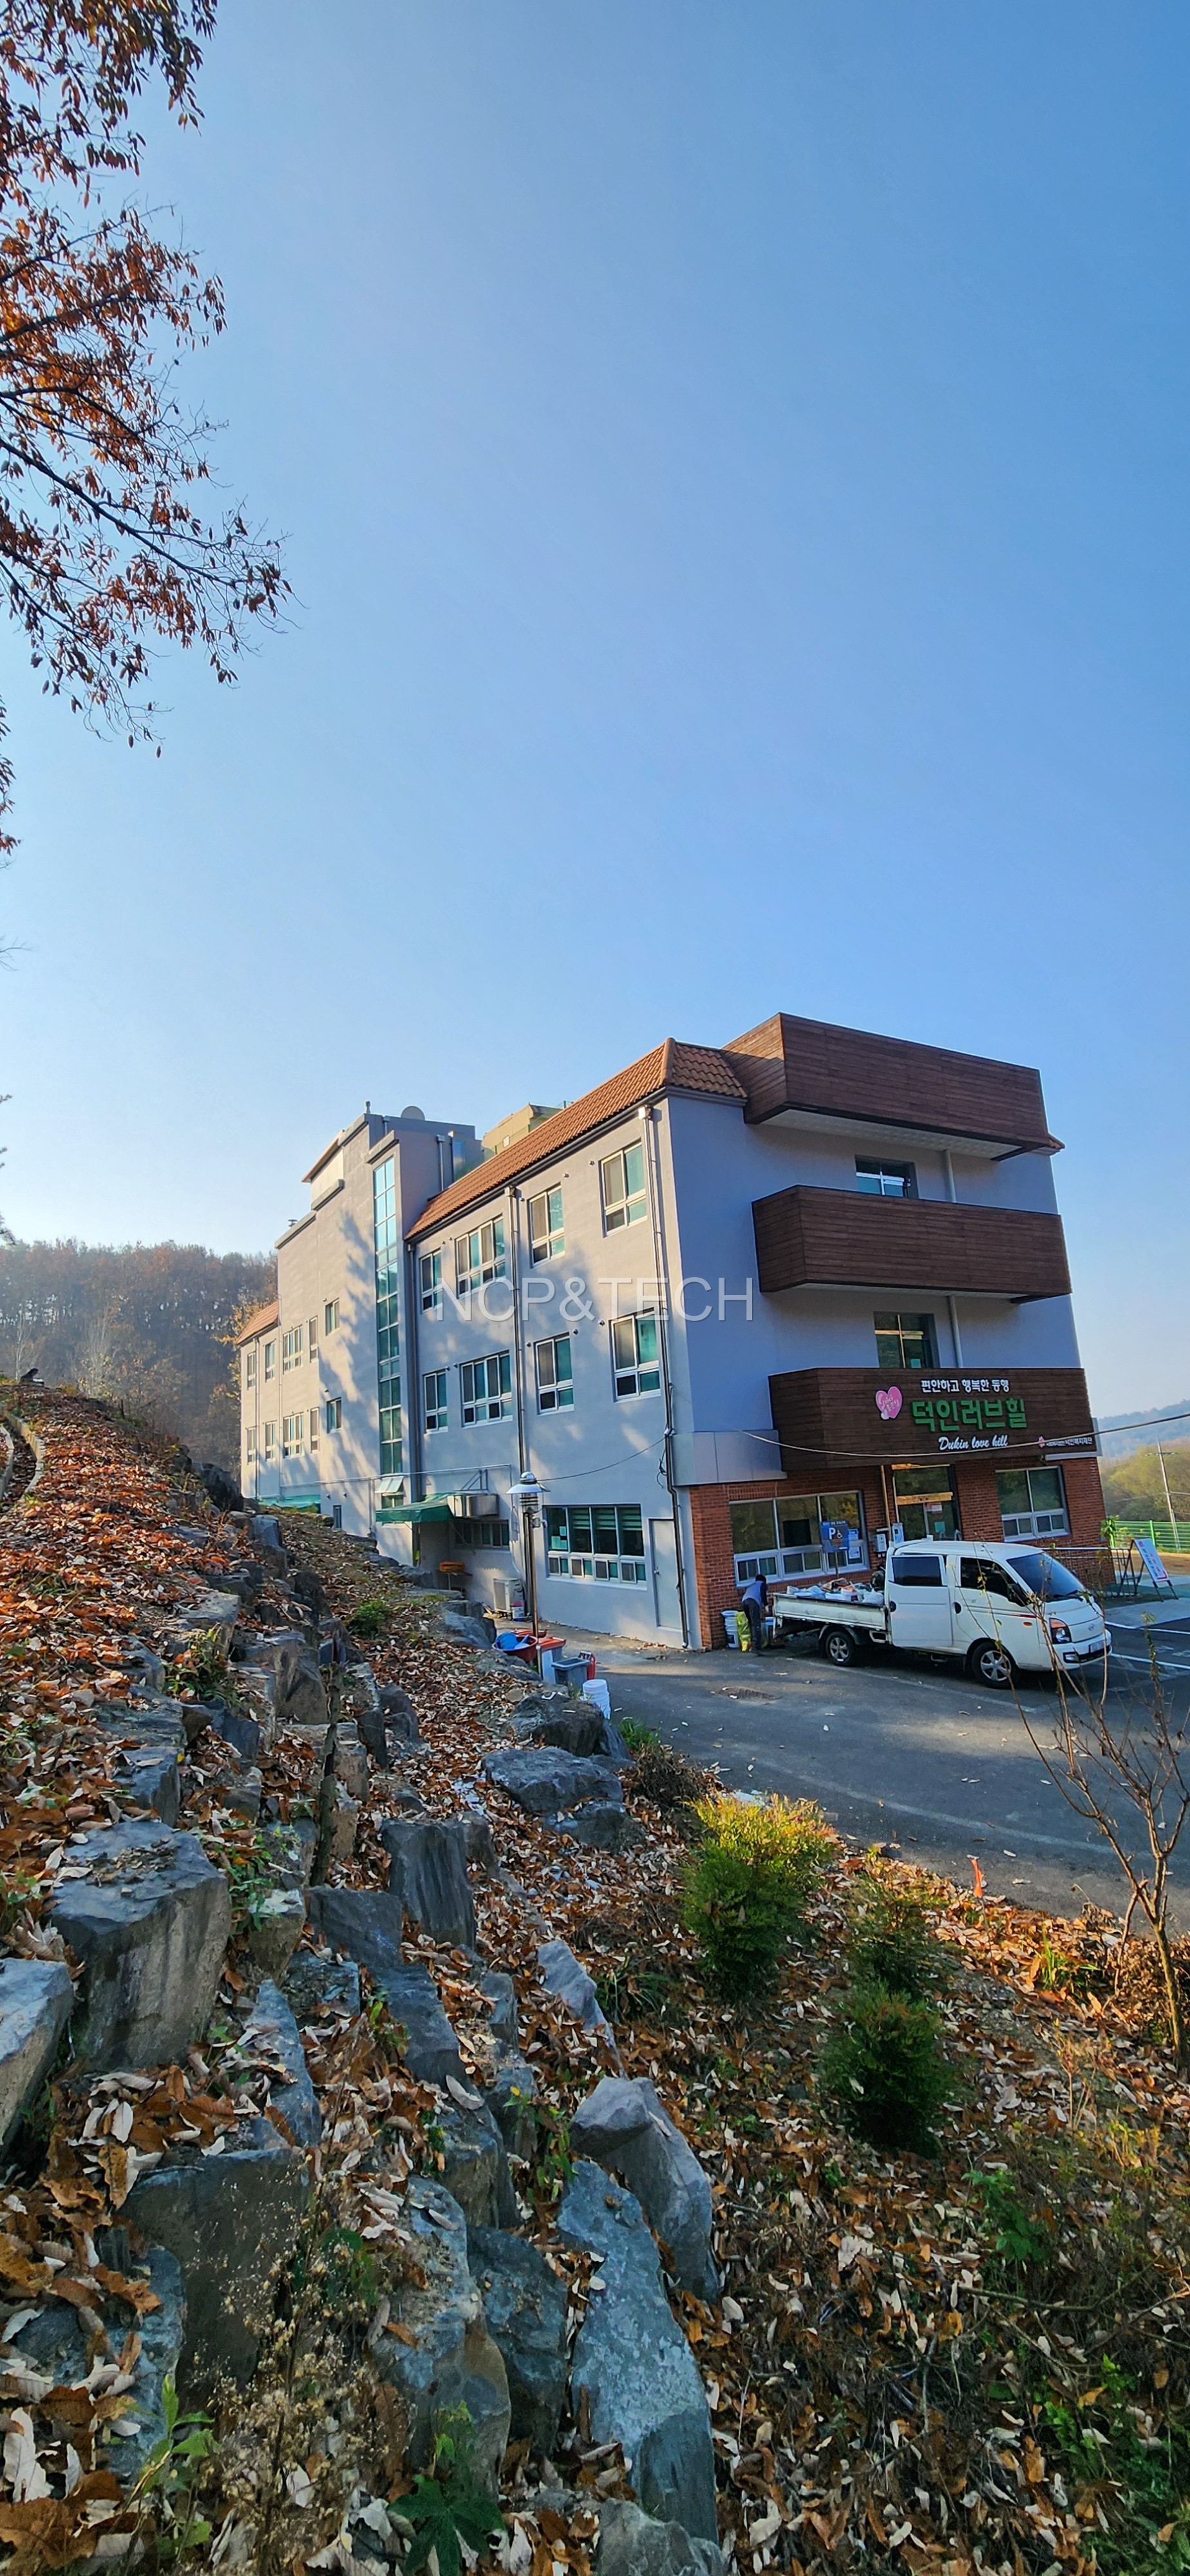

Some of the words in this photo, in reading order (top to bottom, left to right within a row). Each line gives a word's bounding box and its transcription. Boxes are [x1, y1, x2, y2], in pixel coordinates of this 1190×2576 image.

[921, 1379, 959, 1393] 편안하고
[961, 1379, 990, 1394] 행복한
[992, 1379, 1010, 1392] 동행
[912, 1397, 1027, 1432] 덕인러브힐
[938, 1436, 968, 1450] Dukin
[971, 1436, 990, 1448] love
[992, 1434, 1008, 1447] hill
[829, 1527, 836, 1540] P
